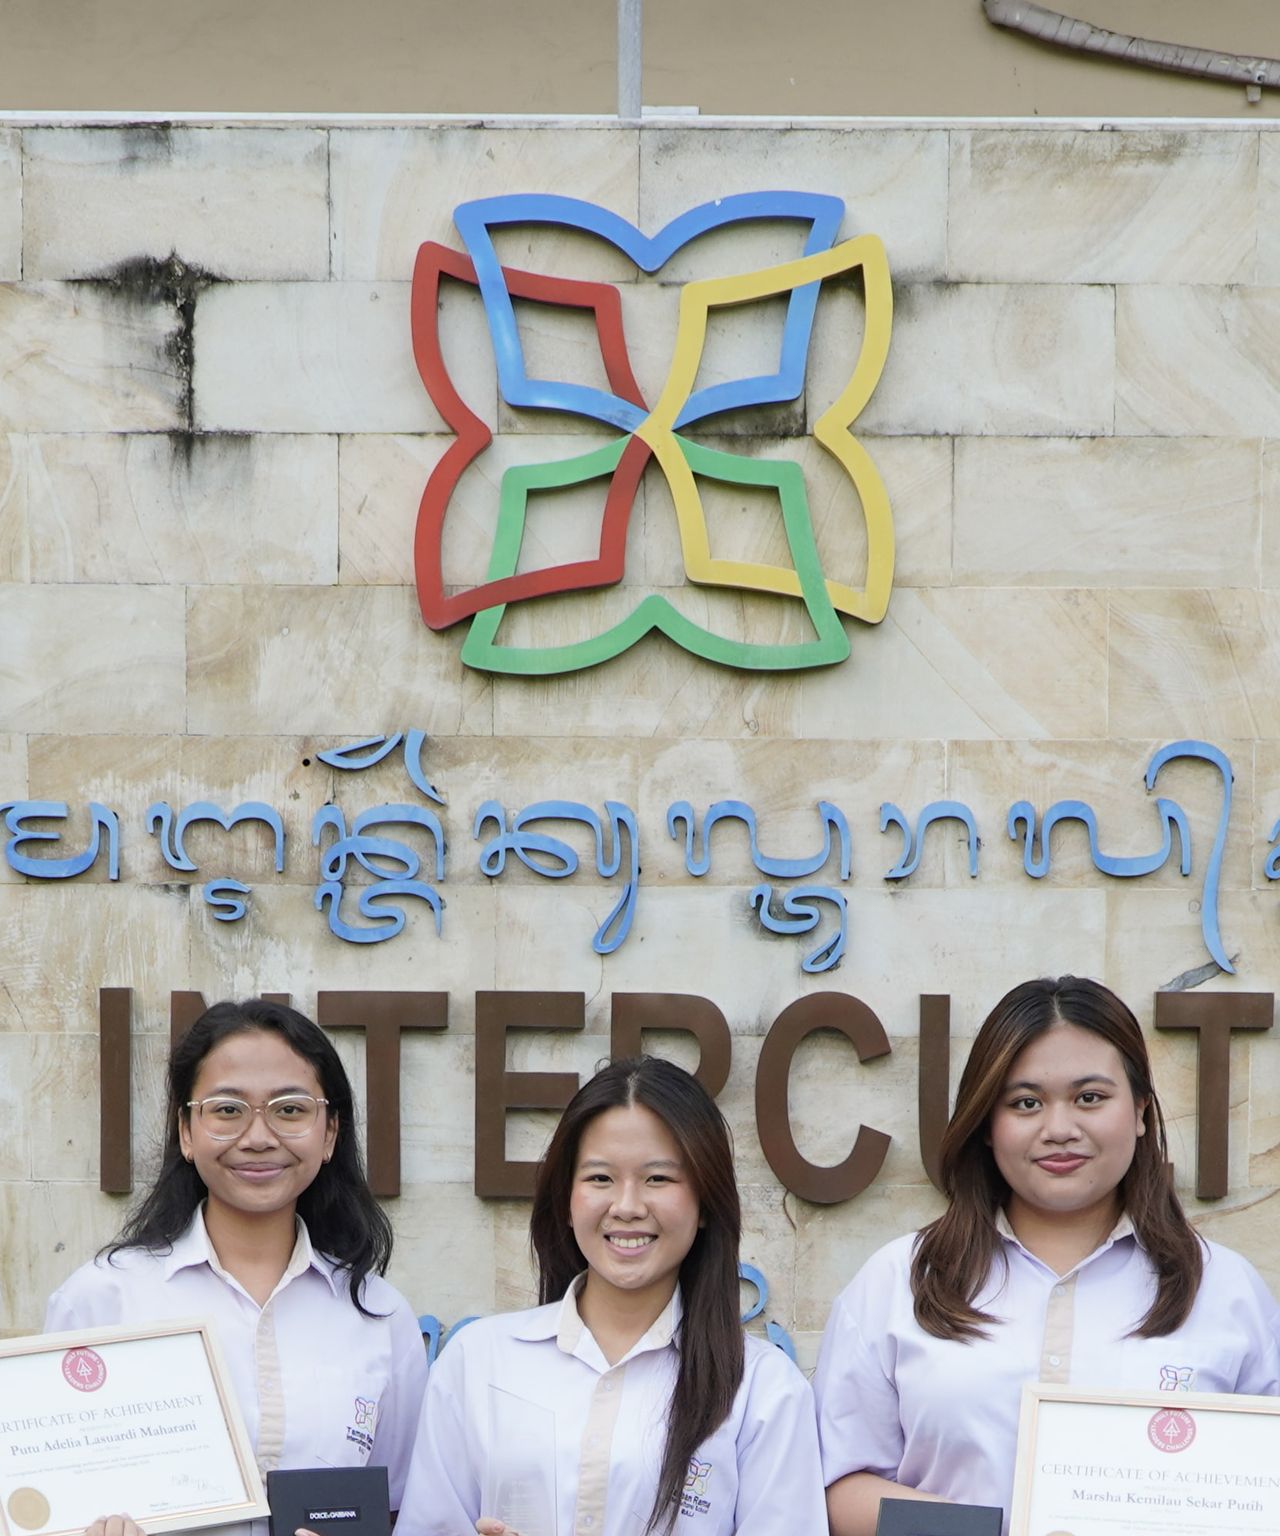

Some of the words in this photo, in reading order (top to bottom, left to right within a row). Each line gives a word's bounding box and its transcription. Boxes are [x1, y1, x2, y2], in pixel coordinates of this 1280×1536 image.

[79, 1409, 99, 1423] OF
[102, 1394, 205, 1420] ACHIEVEMENT
[10, 1442, 40, 1457] Putu
[44, 1436, 82, 1452] Adelia
[140, 1420, 197, 1439] Maharani
[1041, 1463, 1144, 1481] CERTIFICATE
[1148, 1471, 1170, 1482] OF
[1071, 1489, 1121, 1504] Marsha
[1126, 1492, 1182, 1507] Kemilau
[1185, 1496, 1223, 1510] Sekar
[1227, 1499, 1264, 1513] Putih
